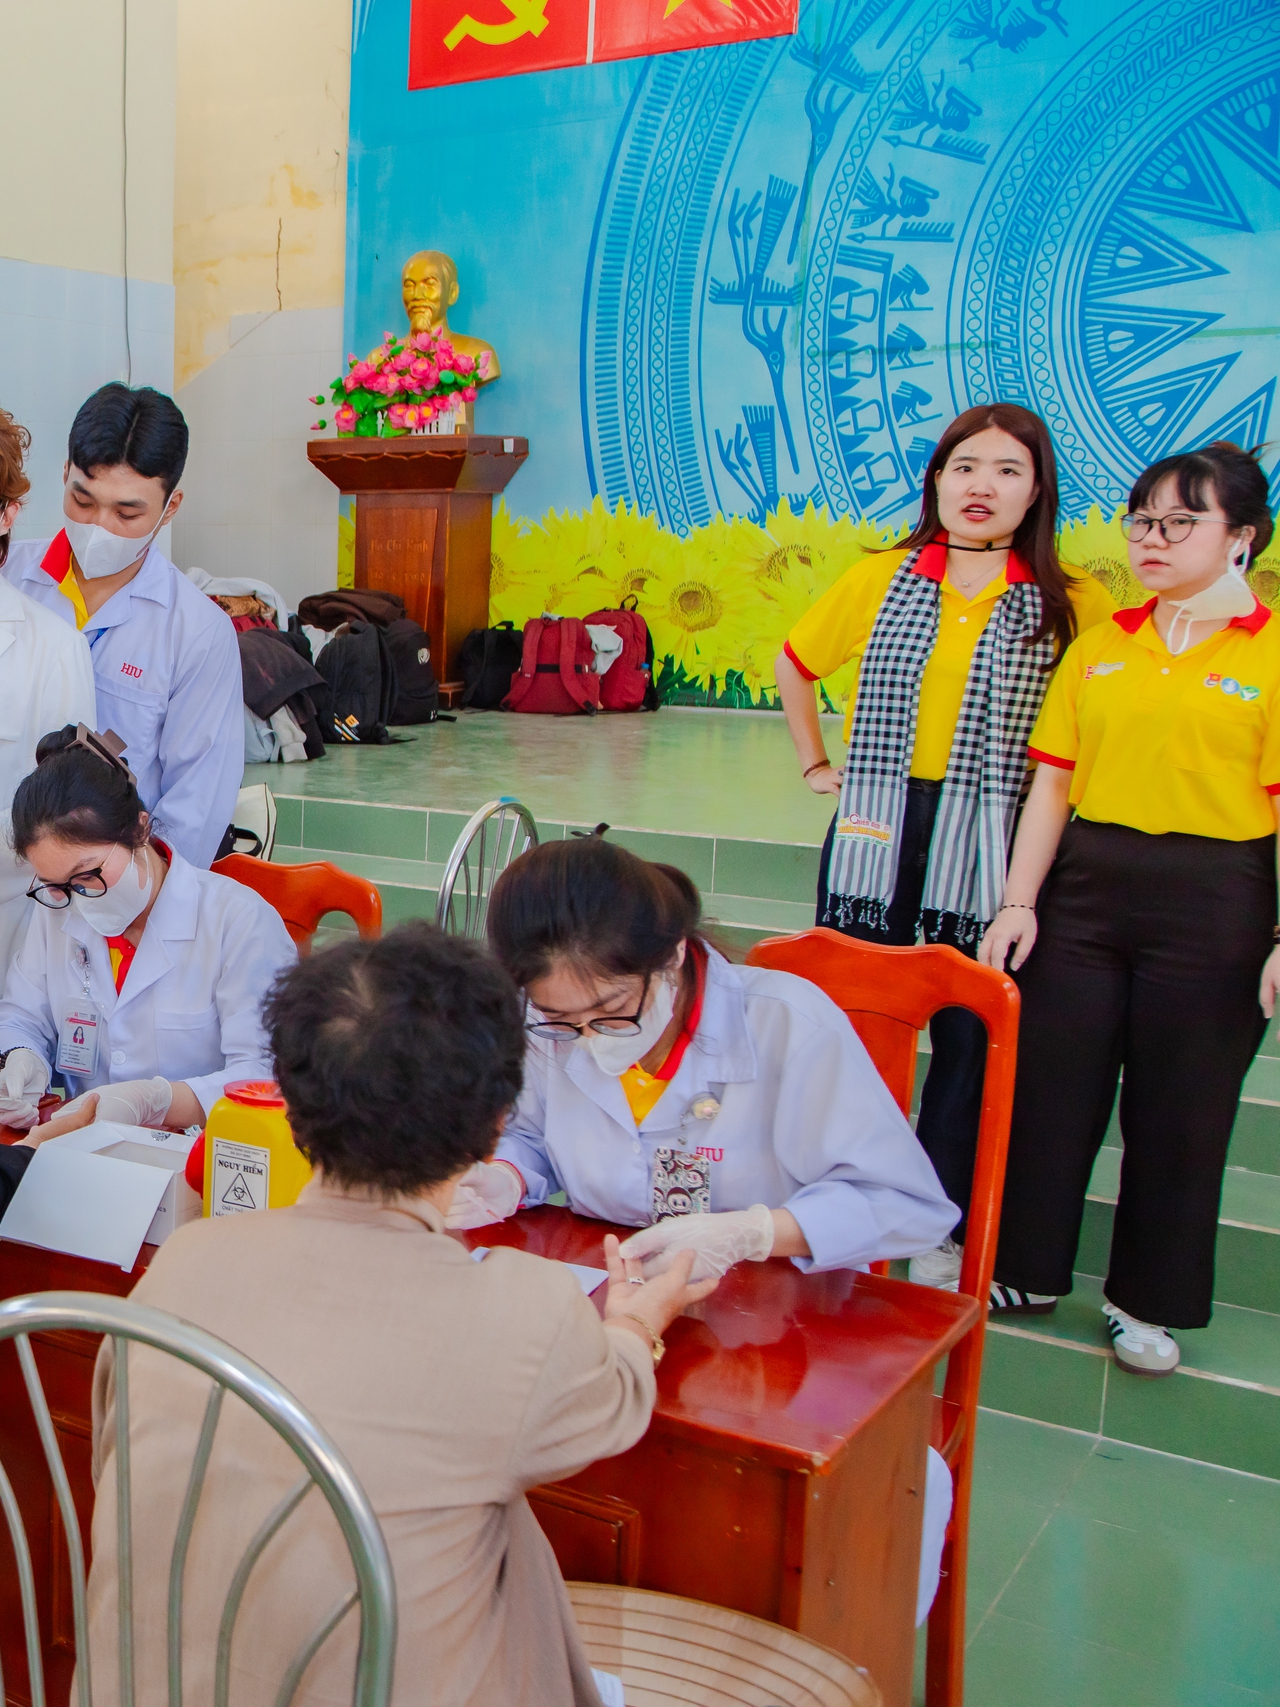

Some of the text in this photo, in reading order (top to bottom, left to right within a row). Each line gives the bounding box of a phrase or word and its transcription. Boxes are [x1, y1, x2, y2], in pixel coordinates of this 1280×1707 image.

[120, 662, 143, 678] HIU
[218, 1160, 264, 1176] NGUY HIỂM
